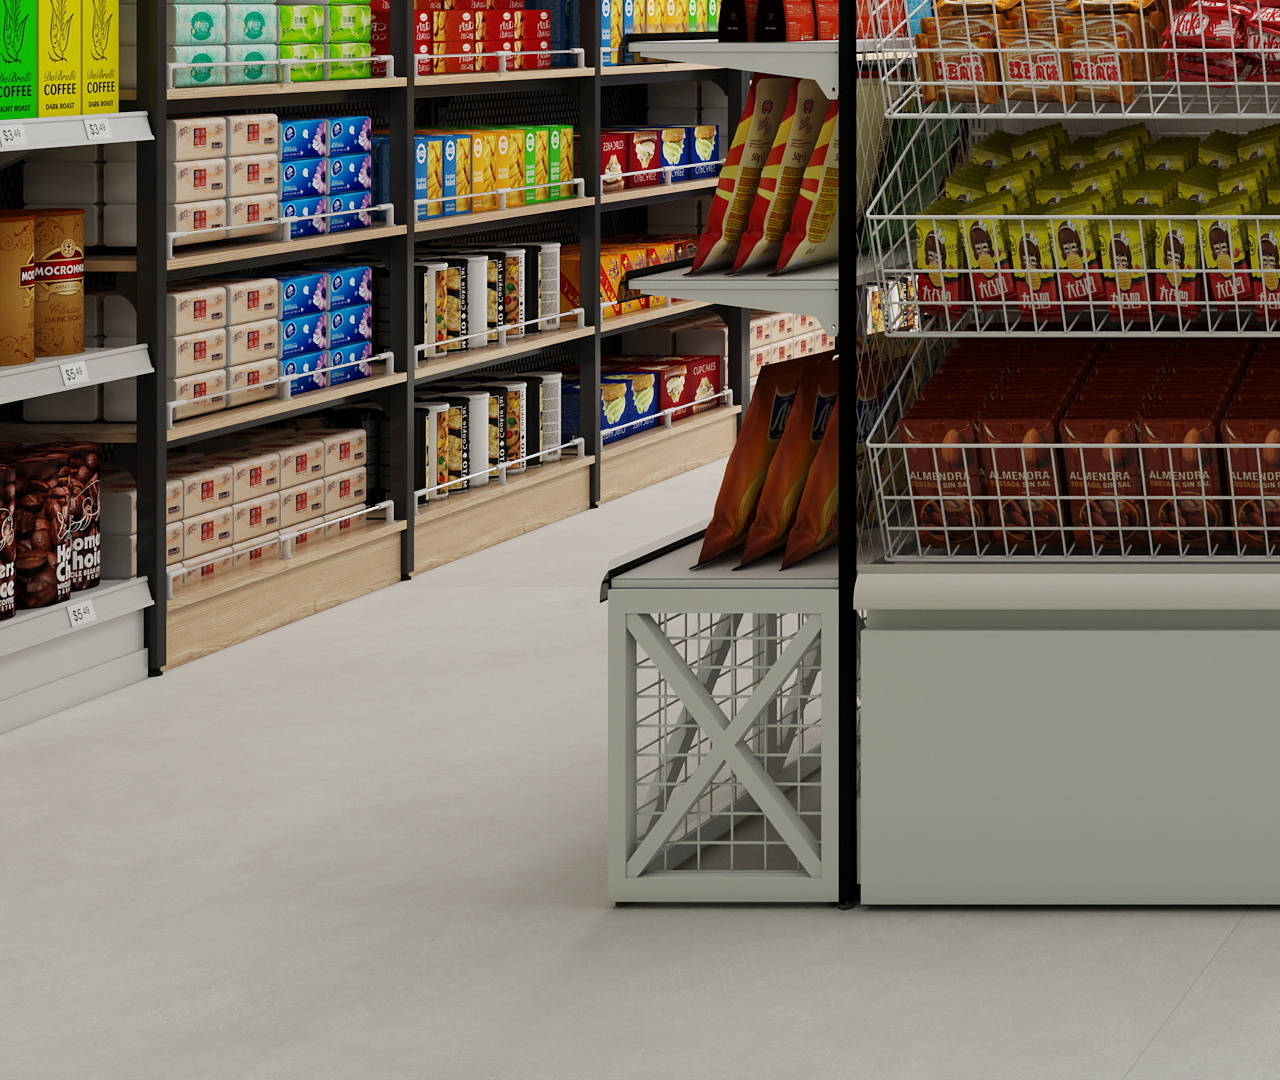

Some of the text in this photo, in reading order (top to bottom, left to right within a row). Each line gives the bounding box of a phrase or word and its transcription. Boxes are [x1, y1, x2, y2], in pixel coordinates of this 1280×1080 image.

[1172, 12, 1206, 34] KitKat
[44, 71, 77, 83] DaBralli
[86, 68, 116, 81] DaBralli
[0, 84, 32, 98] COFFEE
[44, 83, 77, 96] COFFEE
[87, 81, 116, 94] COFFEE
[45, 102, 75, 111] DARK ROAST
[88, 99, 114, 108] DARK ROAST
[0, 104, 31, 114] IGHT ROAST
[45, 315, 66, 324] DARK
[692, 361, 716, 375] CUPCAKES
[910, 471, 970, 481] ALMENDRA
[989, 471, 1050, 480] ALMENDRA
[1070, 471, 1130, 481] ALMENDRA
[1149, 471, 1210, 480] ALMENDRA
[957, 481, 971, 489] SAL
[989, 480, 1051, 489] TOSTADA SAL
[1103, 481, 1116, 489] SIN
